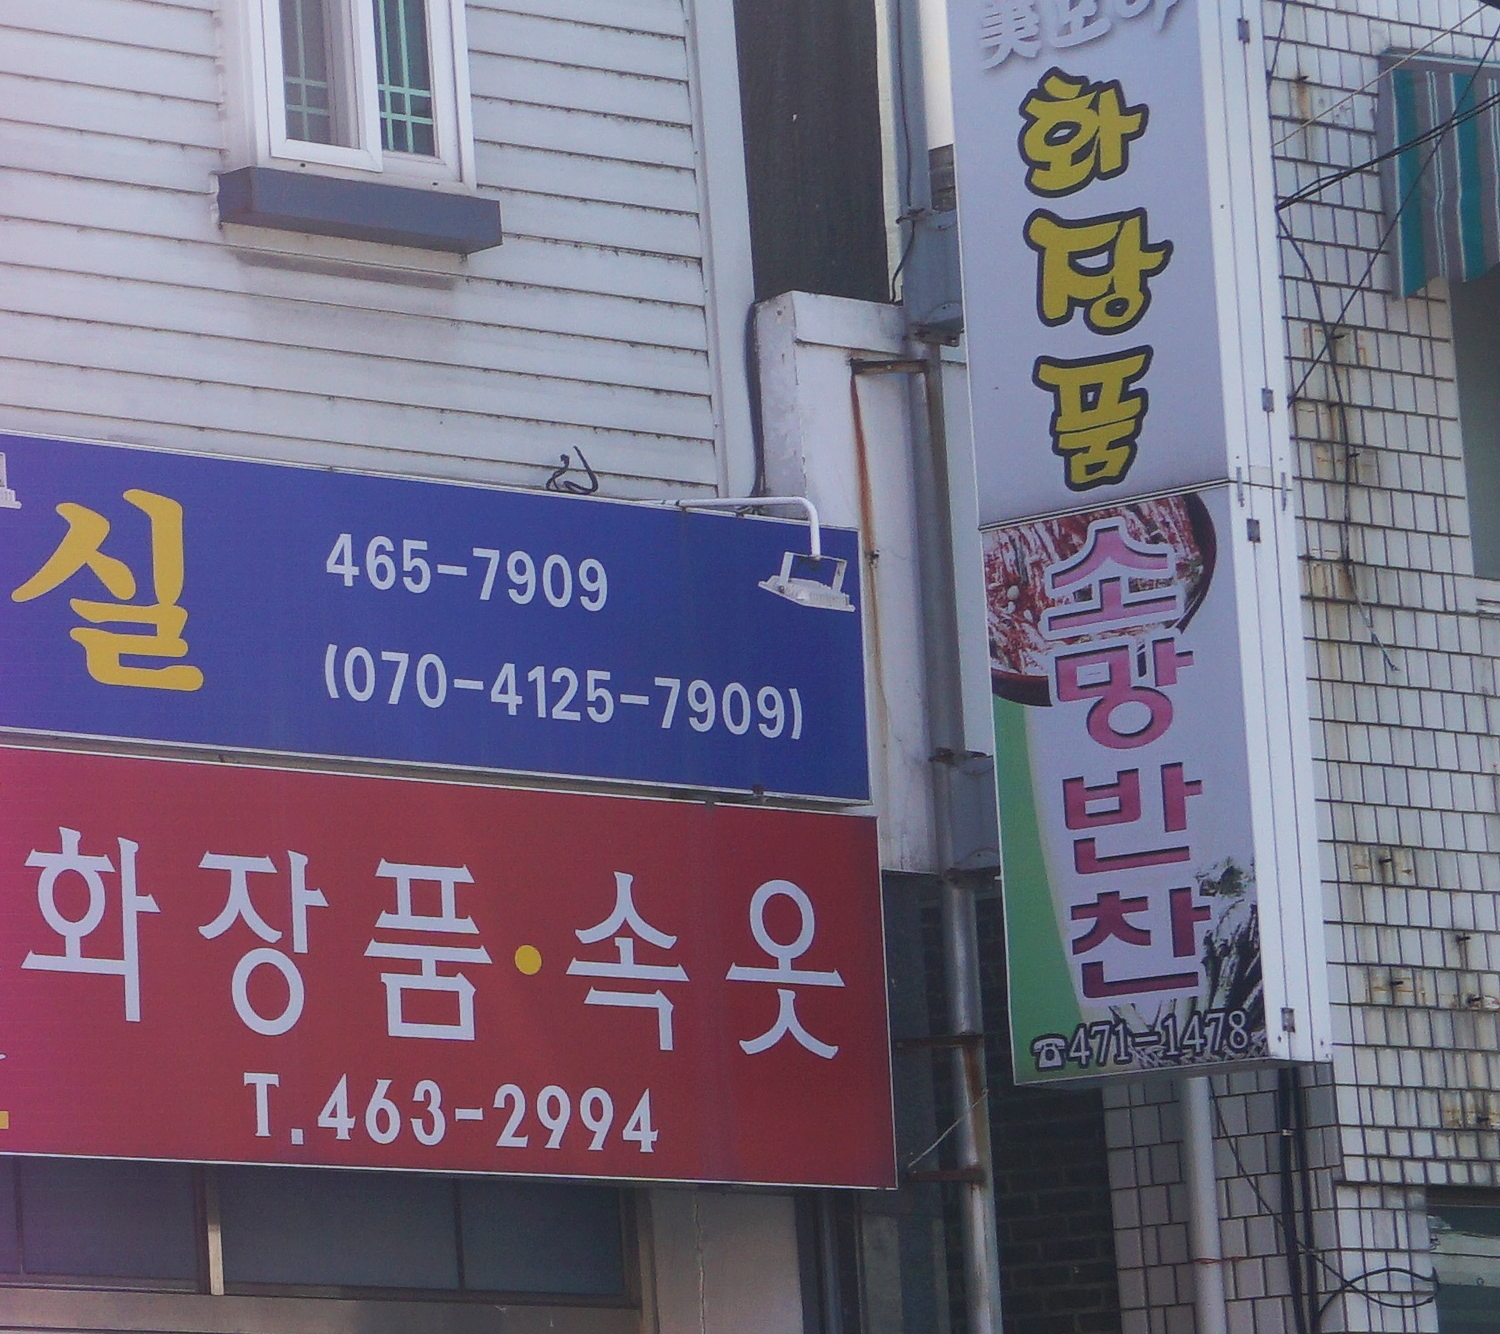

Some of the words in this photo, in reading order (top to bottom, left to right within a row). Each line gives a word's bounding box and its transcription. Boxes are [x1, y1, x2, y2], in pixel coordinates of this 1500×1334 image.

[325, 533, 608, 614] 465-7909
[324, 644, 804, 741] (070-4125-7909)
[1066, 1010, 1249, 1069] 471-1478
[243, 1071, 659, 1154] T.463-2994
